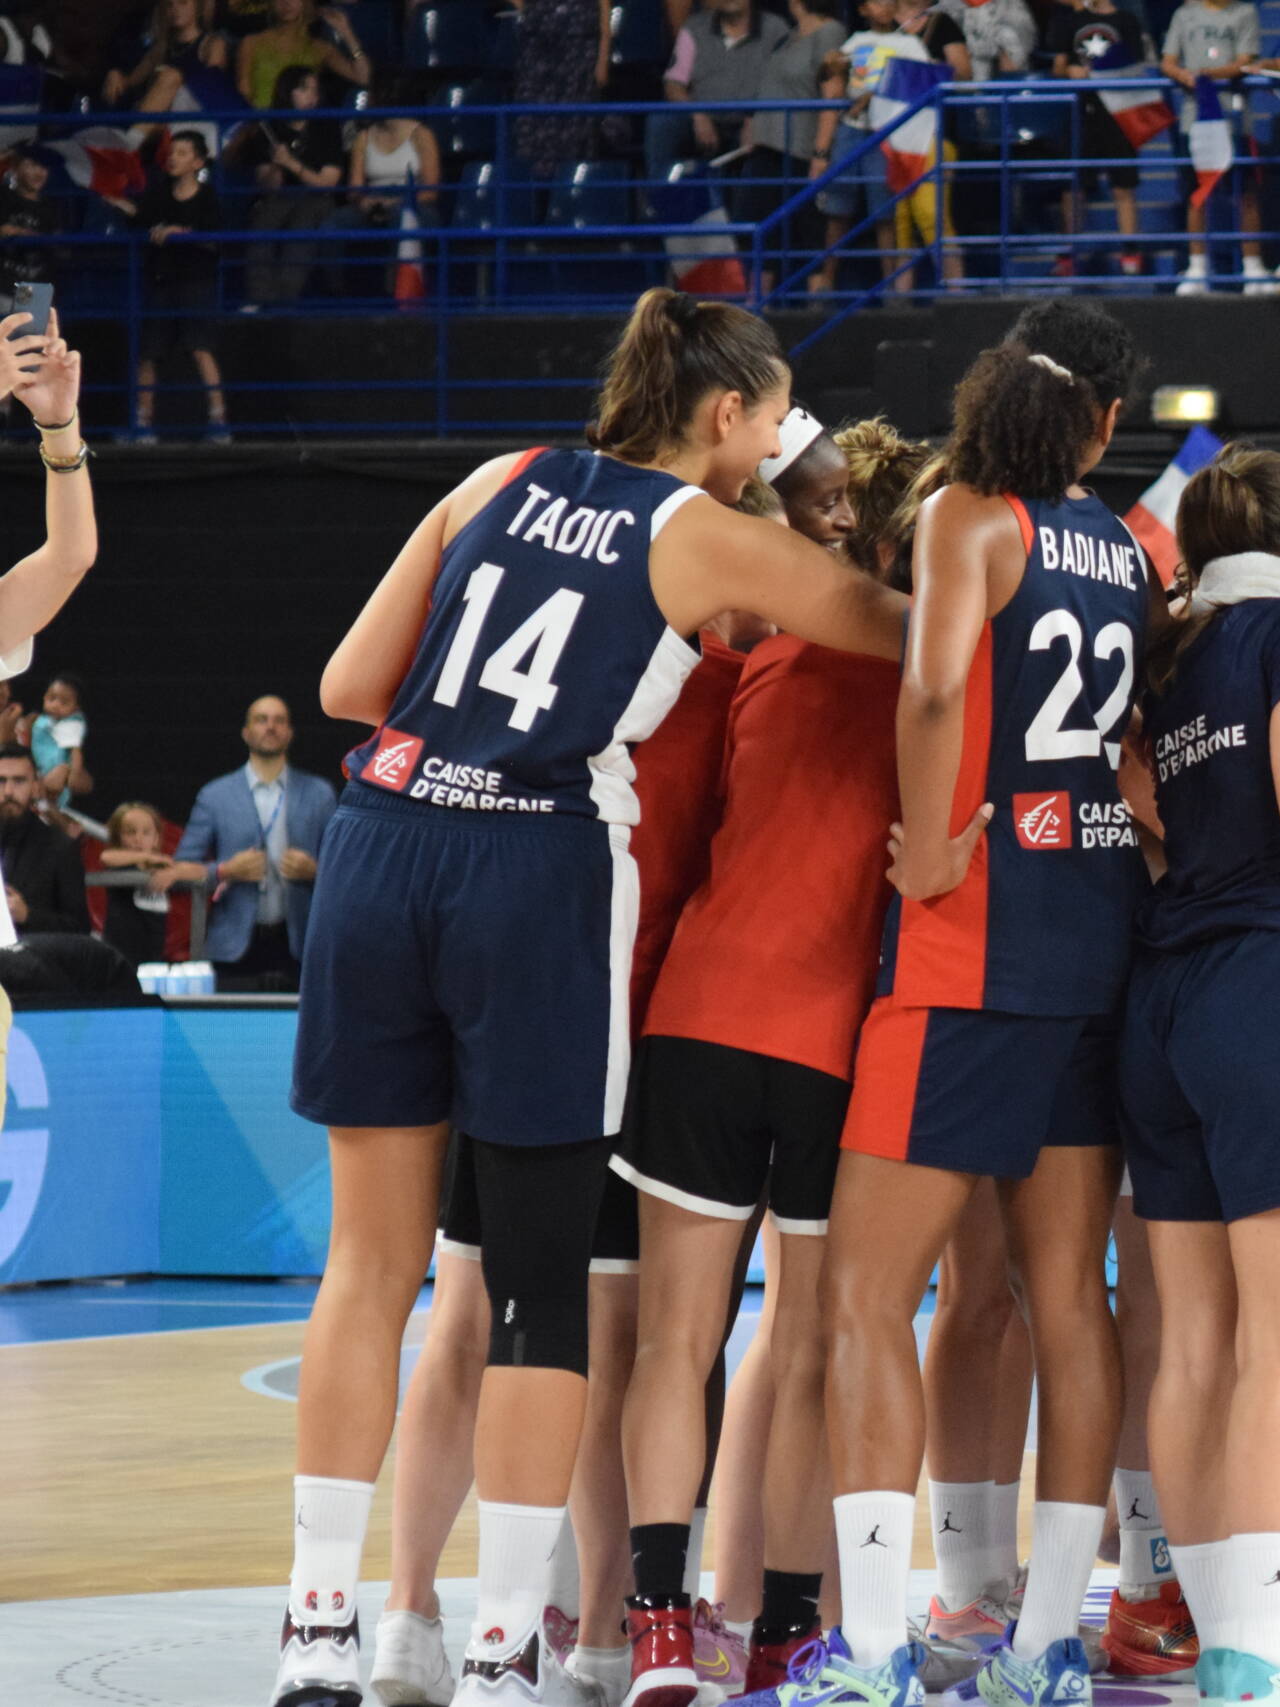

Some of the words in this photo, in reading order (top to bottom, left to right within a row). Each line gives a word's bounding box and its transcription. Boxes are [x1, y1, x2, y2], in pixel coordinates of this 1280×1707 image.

[506, 482, 636, 566] TADIC
[1039, 526, 1138, 592] BADIANE
[433, 561, 584, 732] 14
[1024, 608, 1135, 770] 22
[1155, 714, 1207, 760] CAISSE
[410, 779, 556, 812] D'EPARGNE
[422, 757, 503, 793] CAISSE
[1078, 802, 1131, 824] CAIS
[1081, 827, 1139, 848] D'EPA
